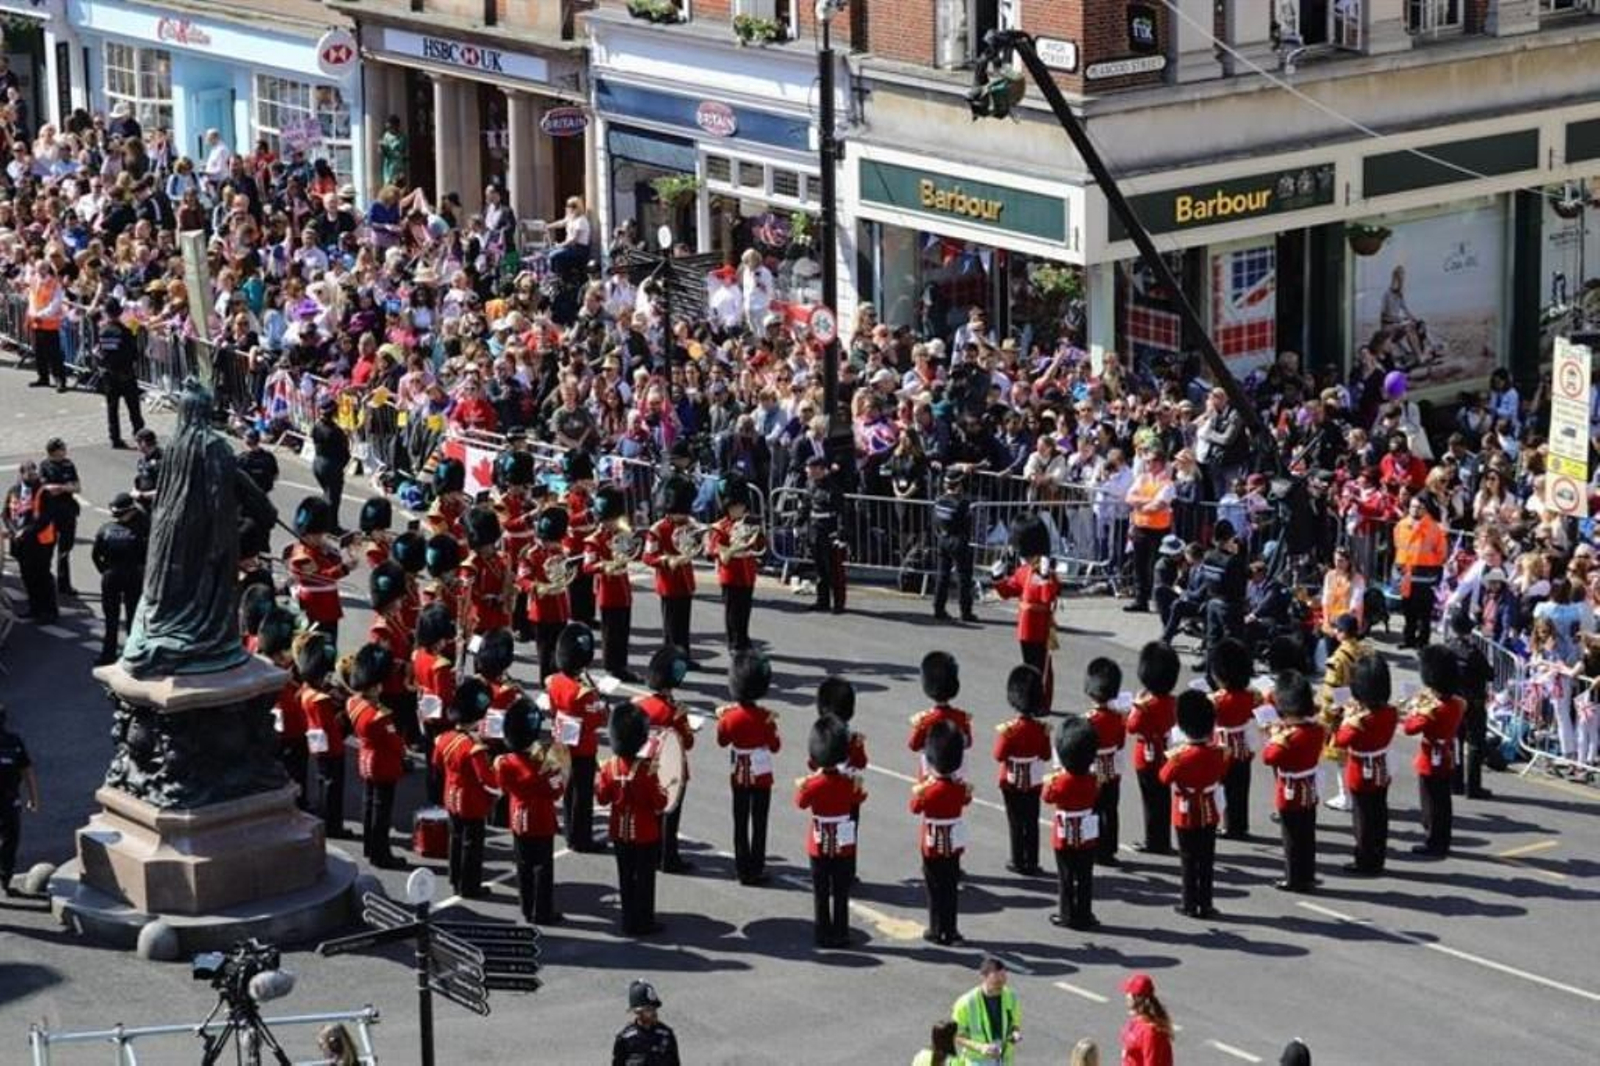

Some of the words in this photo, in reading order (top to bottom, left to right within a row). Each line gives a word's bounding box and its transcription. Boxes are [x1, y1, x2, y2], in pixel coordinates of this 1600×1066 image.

[423, 37, 459, 62] HSBC
[480, 49, 502, 71] UK
[921, 179, 1002, 219] Barbour
[1176, 189, 1272, 222] Barbour
